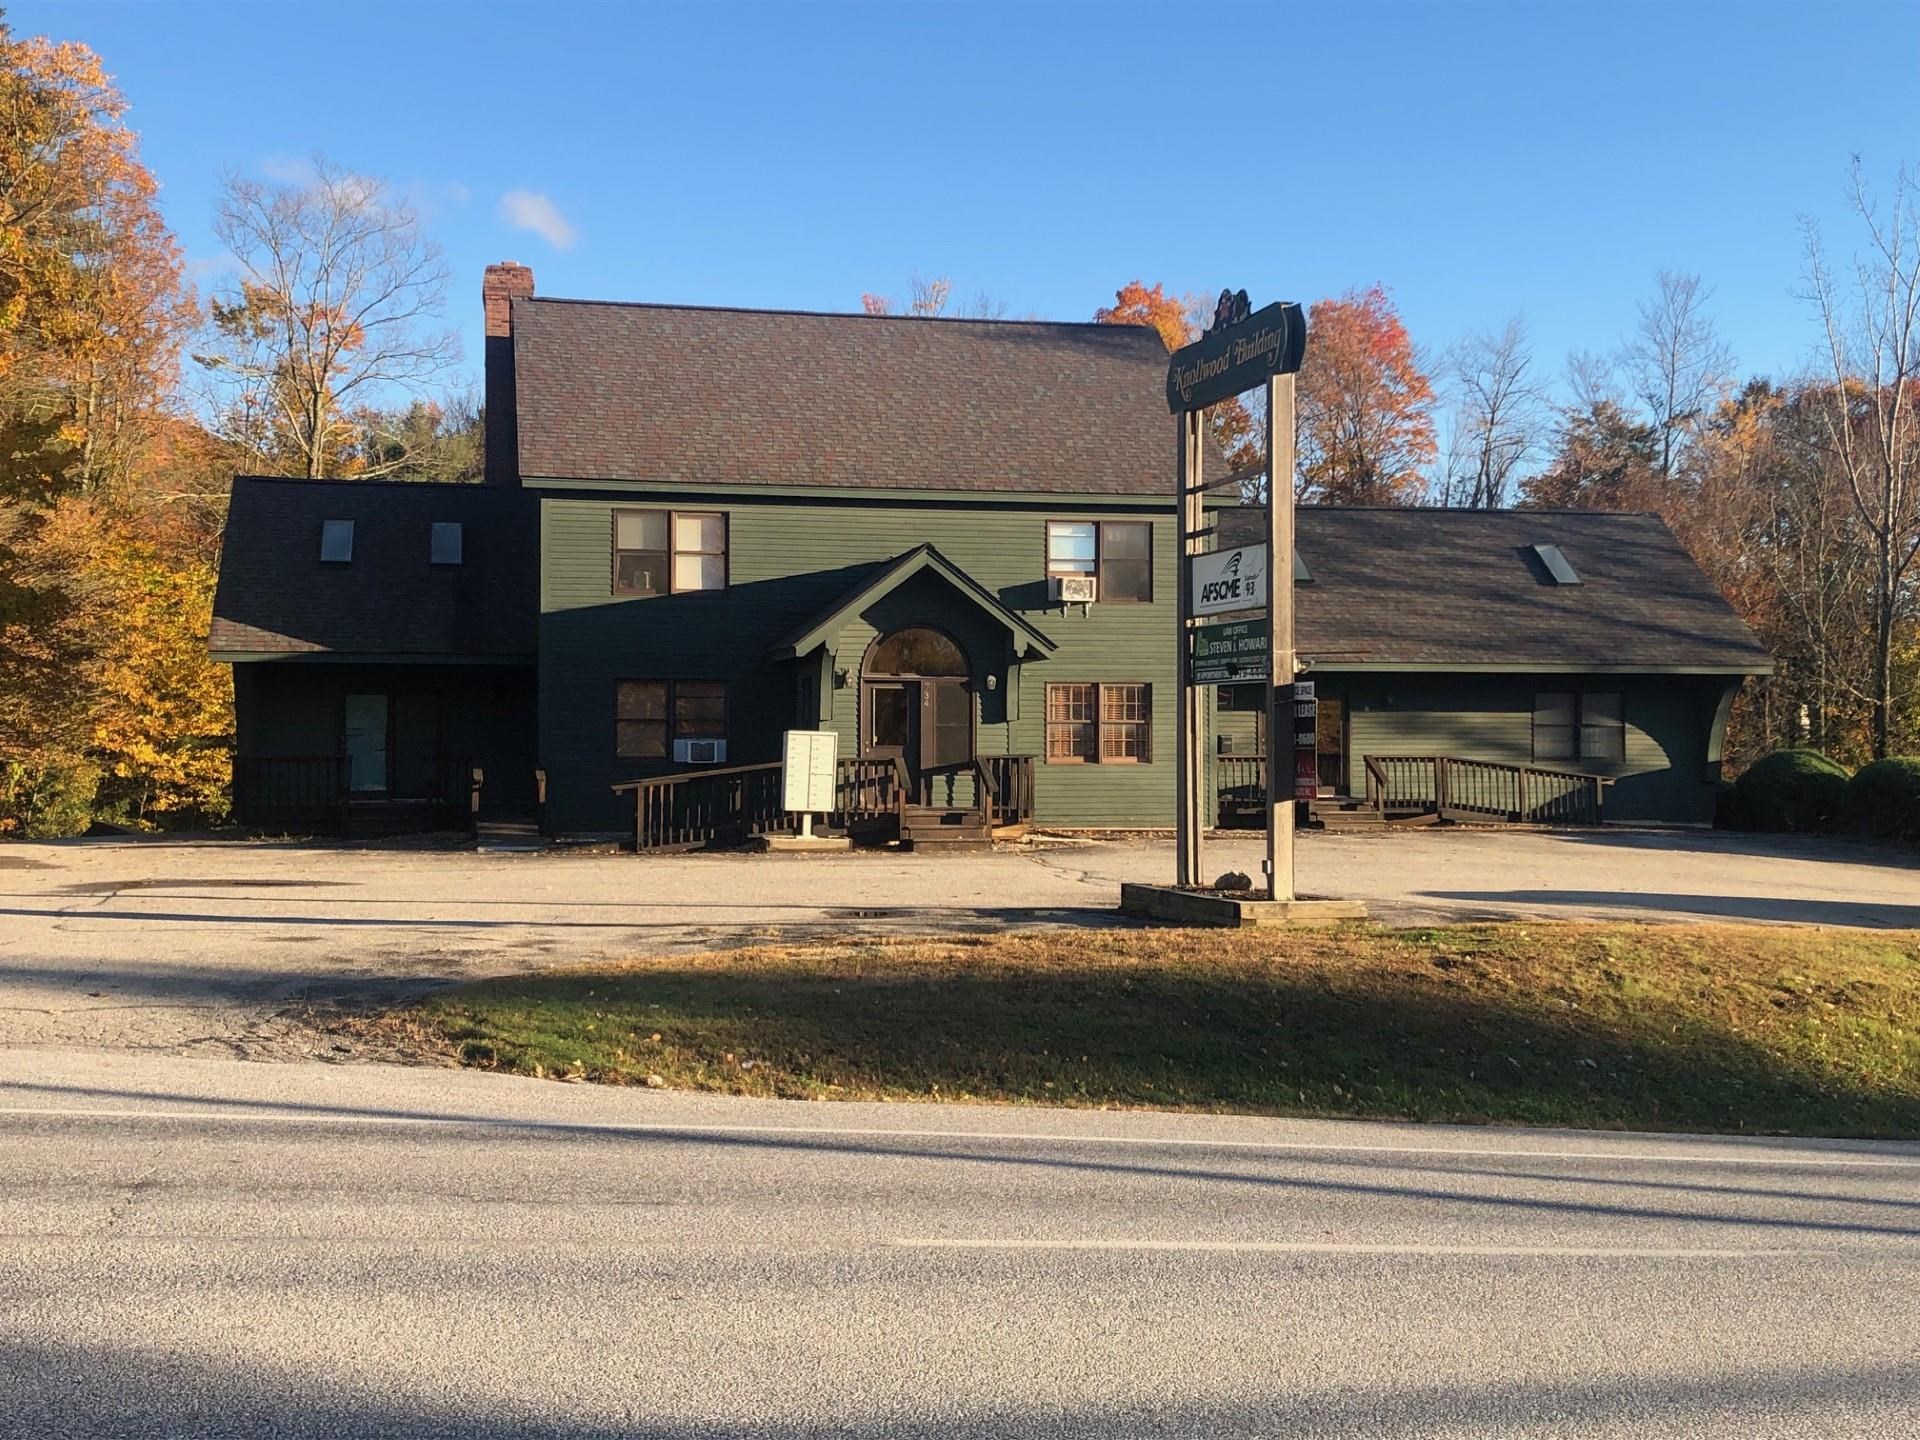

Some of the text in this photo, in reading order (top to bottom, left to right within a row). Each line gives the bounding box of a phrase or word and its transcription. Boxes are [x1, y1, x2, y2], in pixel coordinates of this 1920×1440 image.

[1171, 327, 1282, 402] Knollwood Building
[1200, 577, 1241, 603] AFSCME
[1245, 581, 1256, 597] 93
[1209, 640, 1232, 655] STEVEN
[1239, 636, 1267, 651] HOWAR
[1298, 703, 1316, 718] LEASE
